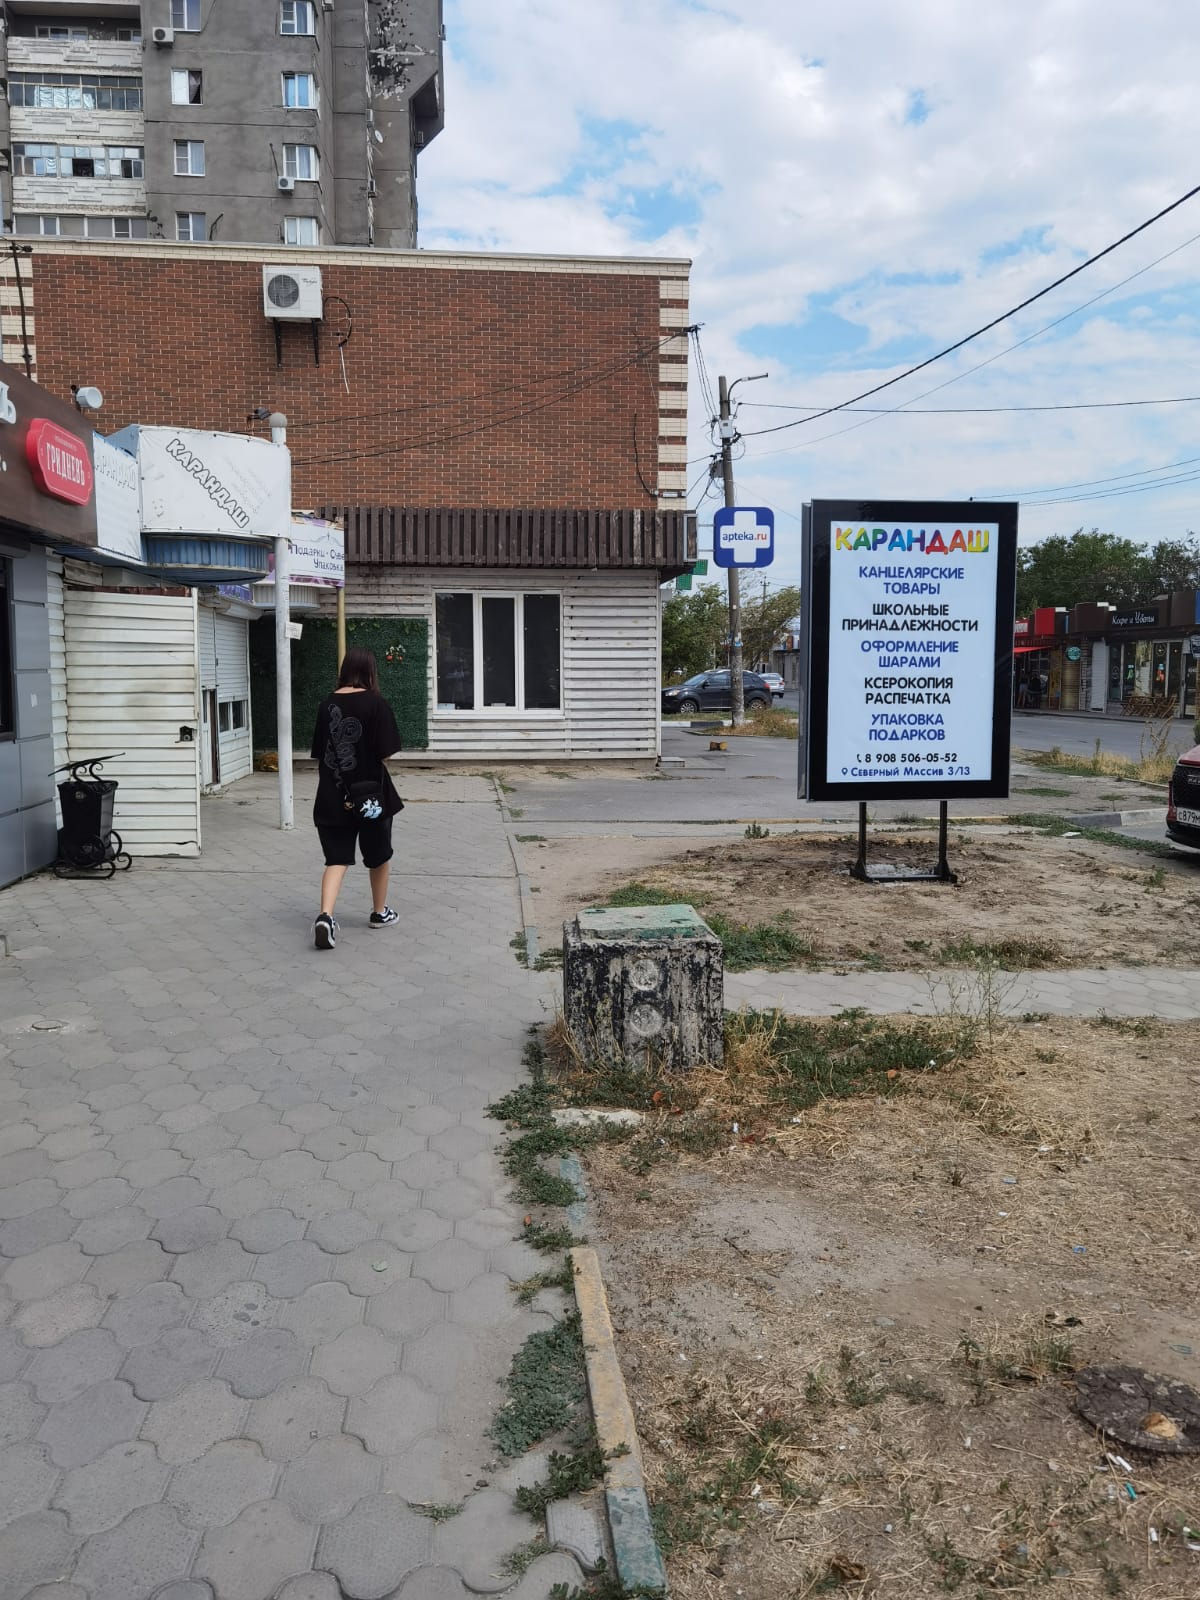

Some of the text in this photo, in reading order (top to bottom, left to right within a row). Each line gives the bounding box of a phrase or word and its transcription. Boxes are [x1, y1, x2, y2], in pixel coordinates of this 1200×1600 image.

[165, 438, 250, 529] КАРАНДАШ
[722, 531, 768, 542] apteka.ru
[835, 527, 989, 555] КАРАНДАШ
[289, 543, 326, 558] Подарки
[858, 566, 965, 580] КАНЦЕЛЯРСКИЕ
[883, 582, 941, 595] ТОВАРЫ
[872, 603, 950, 616] ШКОЛЬНЫЕ
[841, 619, 979, 632] ПРИНАДЛЕЖНОСТИ
[1112, 615, 1129, 627] Кофе
[860, 640, 959, 653] ОФОРМЛЕНИЕ
[878, 656, 941, 668] ШАРАМИ
[864, 676, 953, 689] КСЕРОКОПИЯ
[865, 692, 951, 705] РАСПЕЧАТКА
[871, 713, 945, 726] УПАКОВКА
[868, 729, 946, 741] ПОДАРКОВ
[864, 752, 958, 763] 8 908 506-05-52
[947, 766, 971, 776] 3/13
